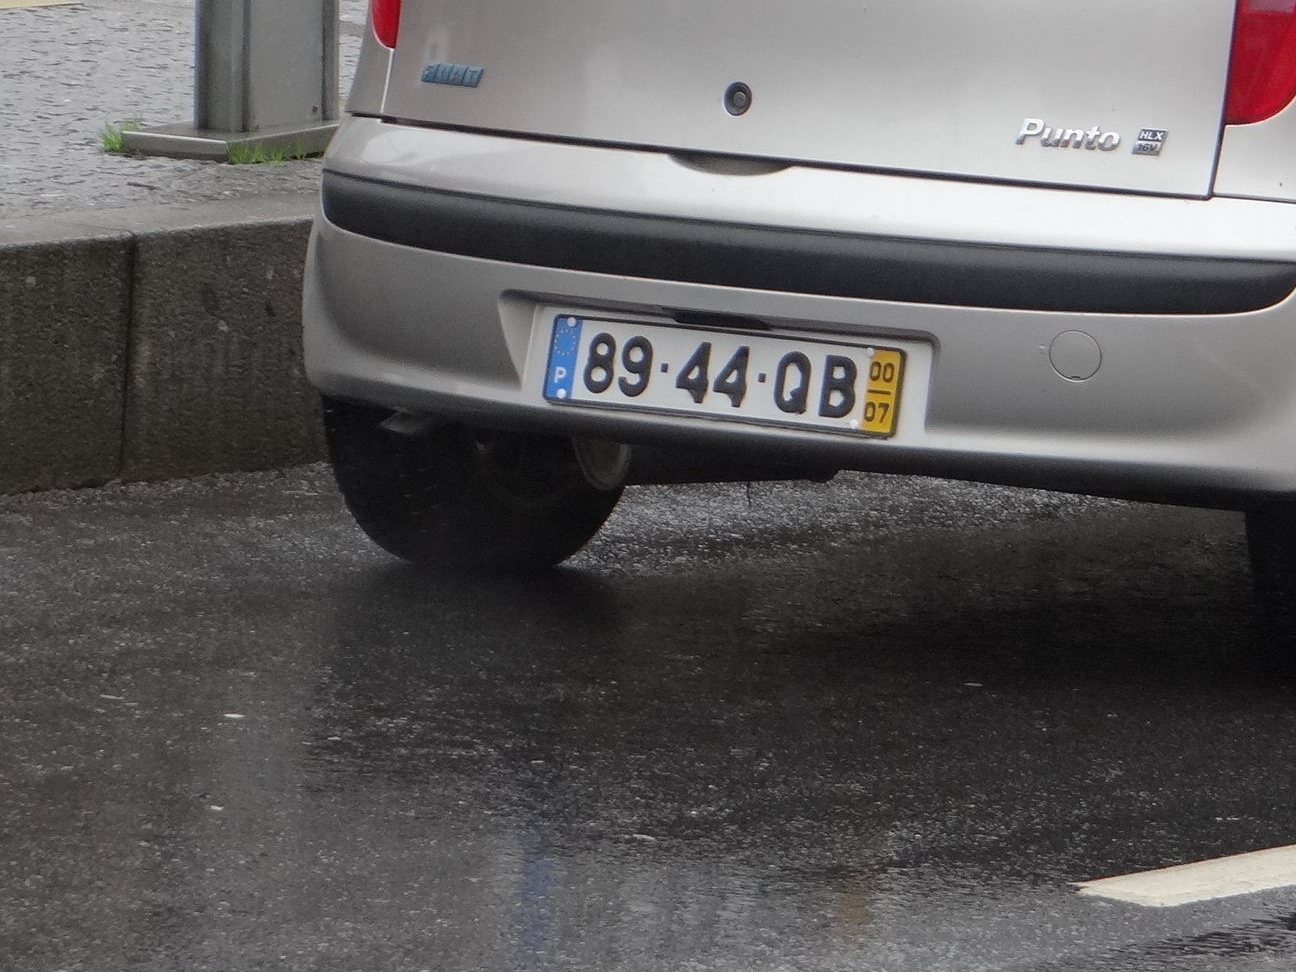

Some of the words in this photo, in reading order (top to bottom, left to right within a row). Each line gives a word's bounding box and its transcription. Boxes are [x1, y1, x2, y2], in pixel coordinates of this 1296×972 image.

[1015, 117, 1121, 152] Punto
[1139, 129, 1166, 141] HLX
[1137, 142, 1159, 153] 16V
[553, 365, 567, 385] P
[869, 360, 895, 383] 00
[863, 401, 890, 424] 07
